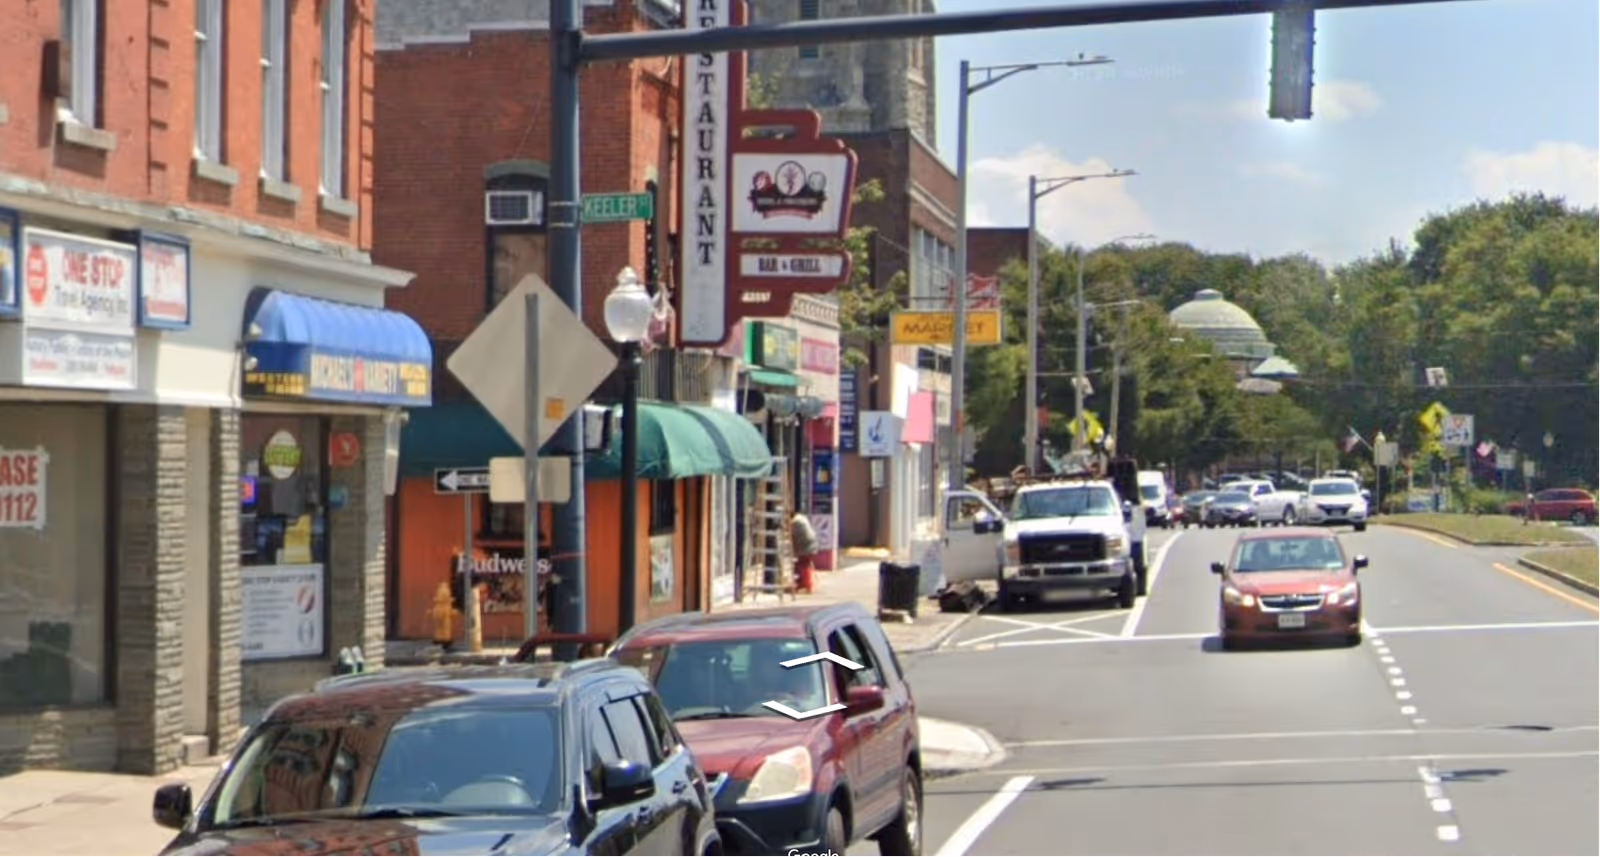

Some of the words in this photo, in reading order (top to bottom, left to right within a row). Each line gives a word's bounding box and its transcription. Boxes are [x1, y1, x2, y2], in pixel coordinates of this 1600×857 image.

[583, 196, 637, 219] KEELER
[62, 249, 89, 284] ONE
[92, 255, 125, 289] STOP
[758, 256, 778, 273] BAR
[789, 256, 822, 273] GRILL
[55, 285, 78, 308] Travel
[80, 290, 114, 317] Agency
[0, 454, 39, 487] ASE
[0, 491, 39, 522] 112
